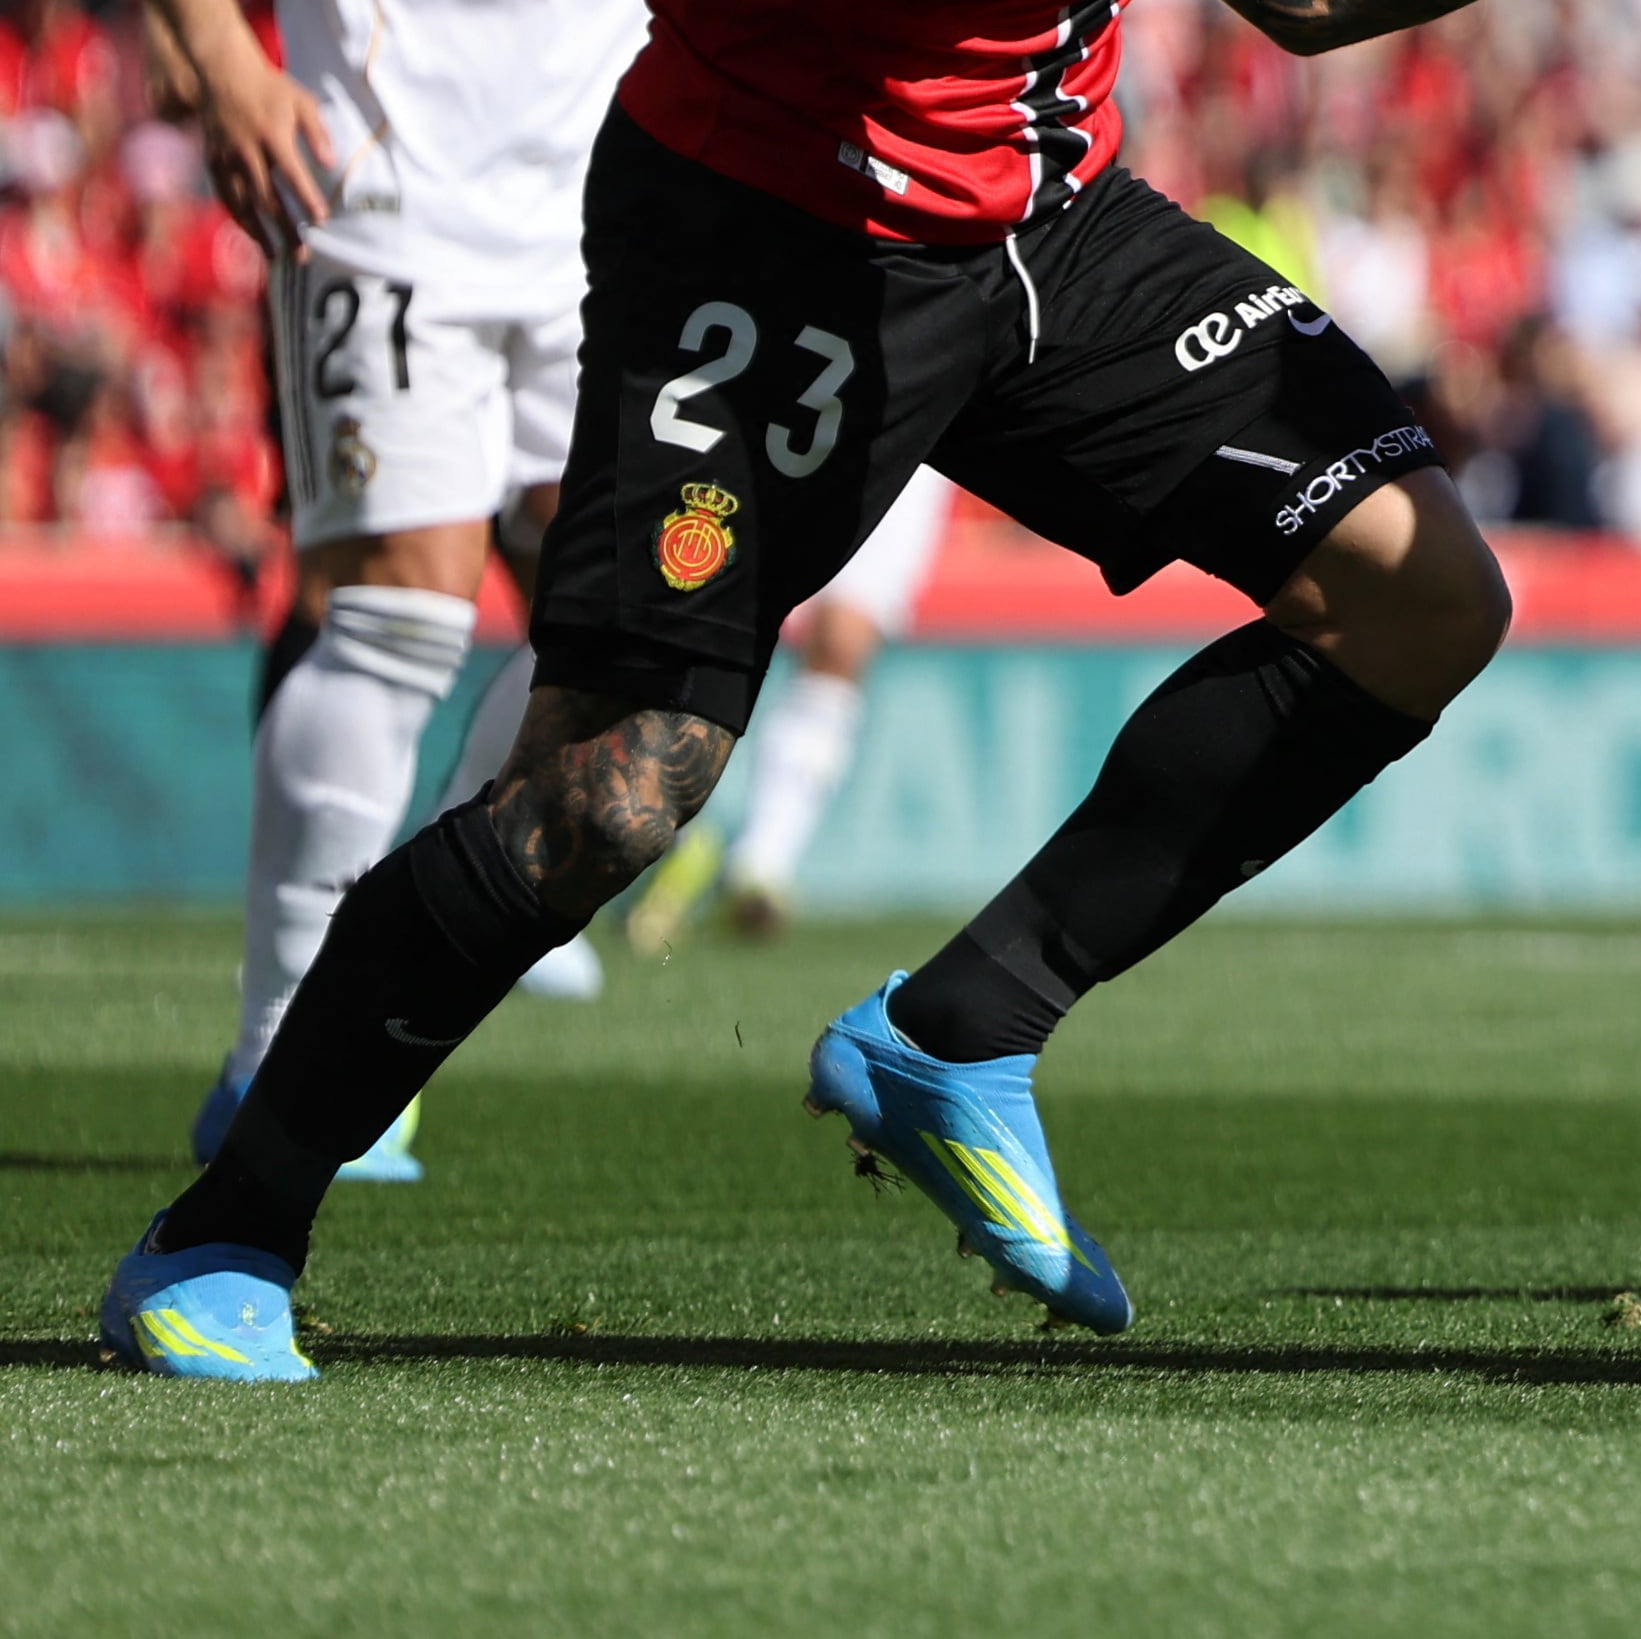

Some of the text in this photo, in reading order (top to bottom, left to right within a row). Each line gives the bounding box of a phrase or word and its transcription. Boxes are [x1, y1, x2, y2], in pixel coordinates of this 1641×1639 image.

[315, 278, 413, 400] 21
[650, 301, 854, 478] 23
[1276, 425, 1435, 535] SHORTYSTRA
